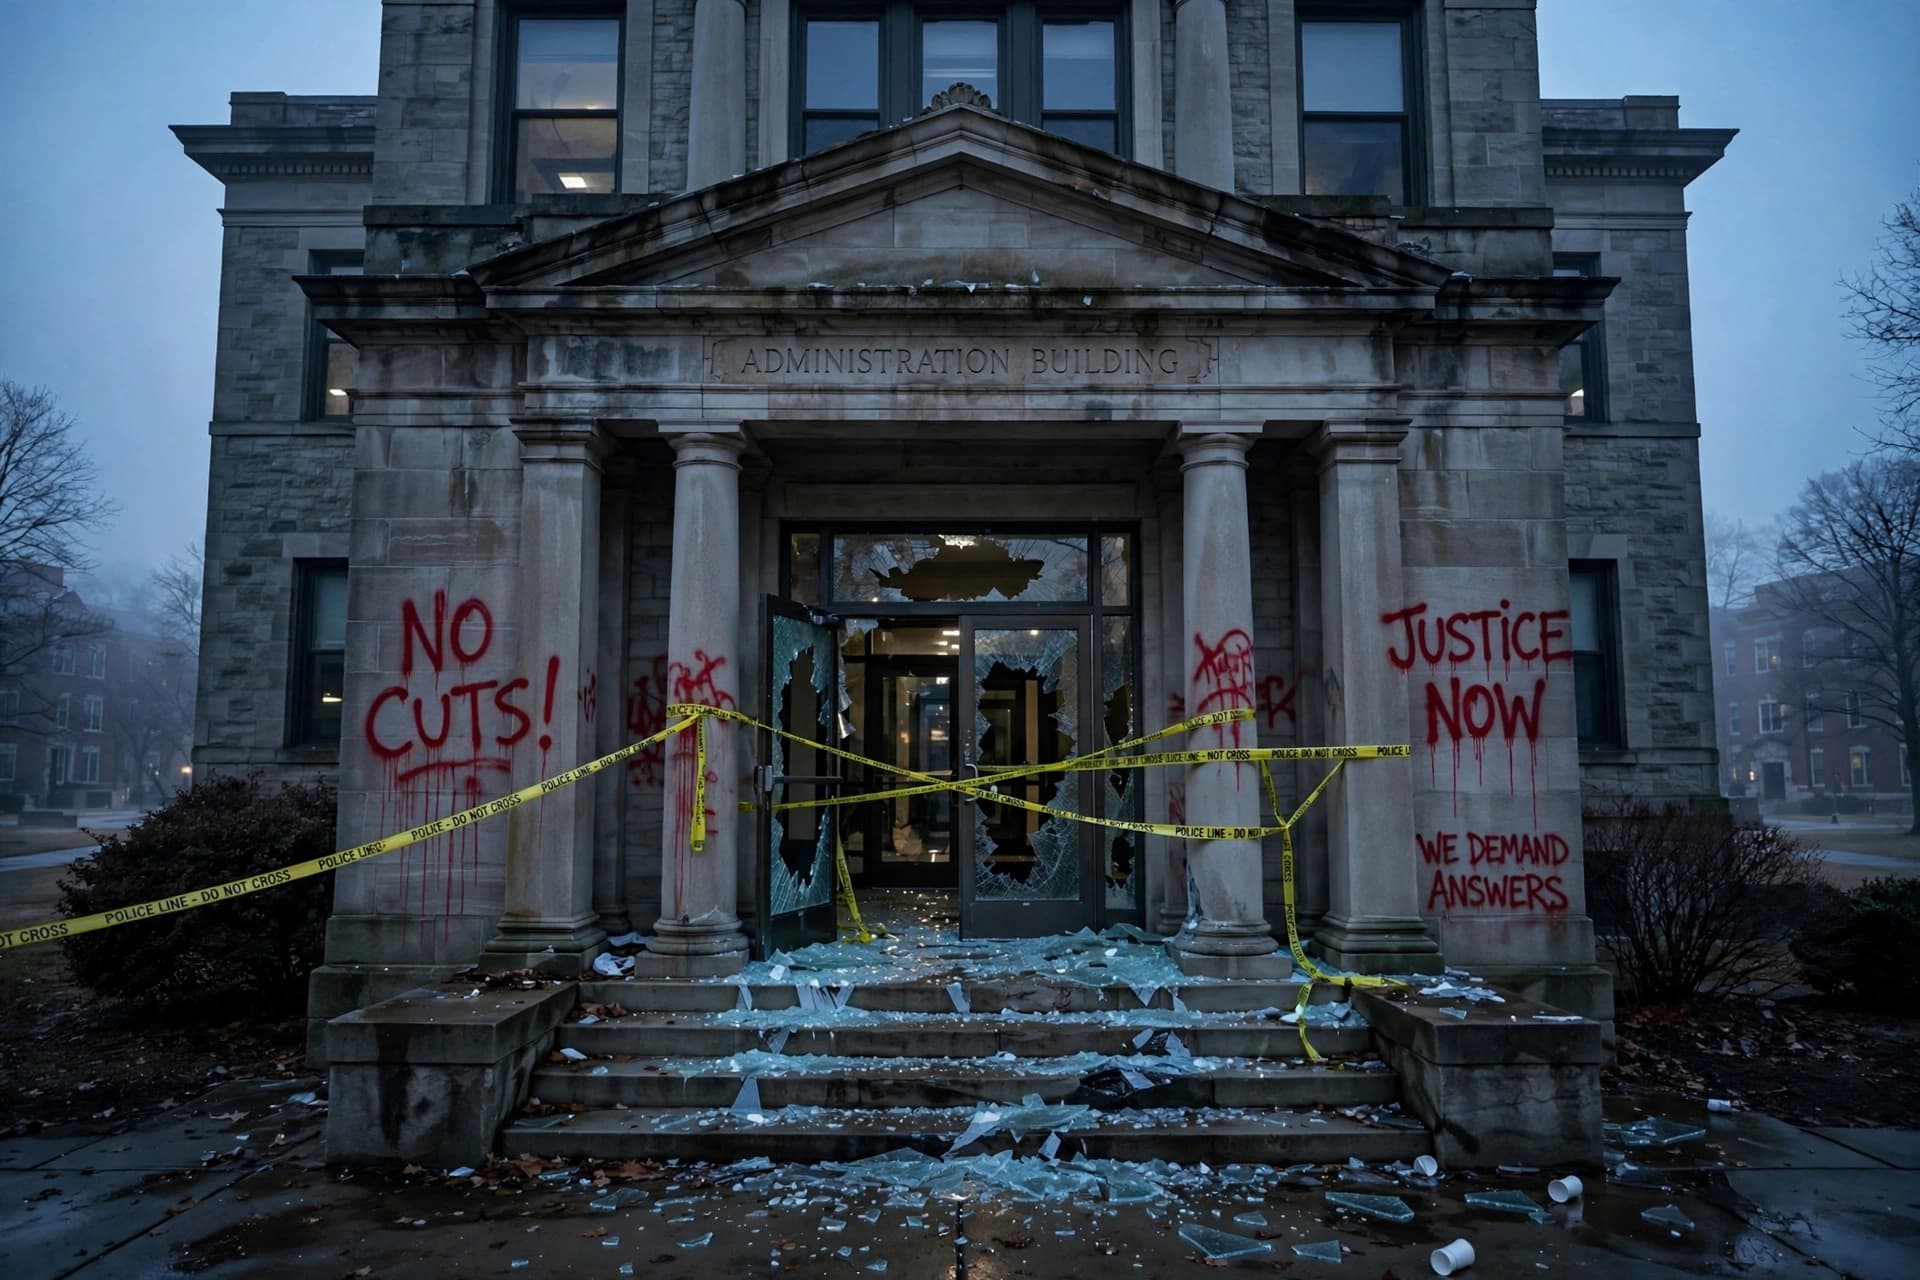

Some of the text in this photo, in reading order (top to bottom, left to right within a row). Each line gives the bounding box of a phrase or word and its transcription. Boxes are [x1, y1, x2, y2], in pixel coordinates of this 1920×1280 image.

[741, 348, 1179, 376] ADMINISTRATION BUILDING
[402, 589, 493, 676] NO
[365, 655, 560, 759] CUTS!
[1425, 677, 1546, 746] NOW
[1207, 751, 1223, 760] NOT
[1271, 749, 1298, 759] POLICE
[1377, 746, 1403, 756] POLICE
[19, 923, 69, 943] CROSS
[104, 905, 155, 924] POLICE
[159, 896, 188, 913] LINE
[201, 889, 220, 903] DO
[223, 881, 248, 899] NOT
[252, 870, 291, 889] CROSS
[318, 851, 357, 870] POLICE
[452, 814, 467, 827] DO
[469, 806, 489, 821] NOT
[490, 794, 521, 813] CROSS
[541, 773, 572, 793] POLICE
[573, 765, 593, 780] LINE
[600, 756, 612, 768] DO
[1175, 826, 1204, 838] POLICE
[1207, 828, 1226, 839] LINE
[1234, 828, 1246, 839] DO
[1415, 831, 1569, 867] WE DEMAND
[1427, 870, 1569, 913] ANSWERS
